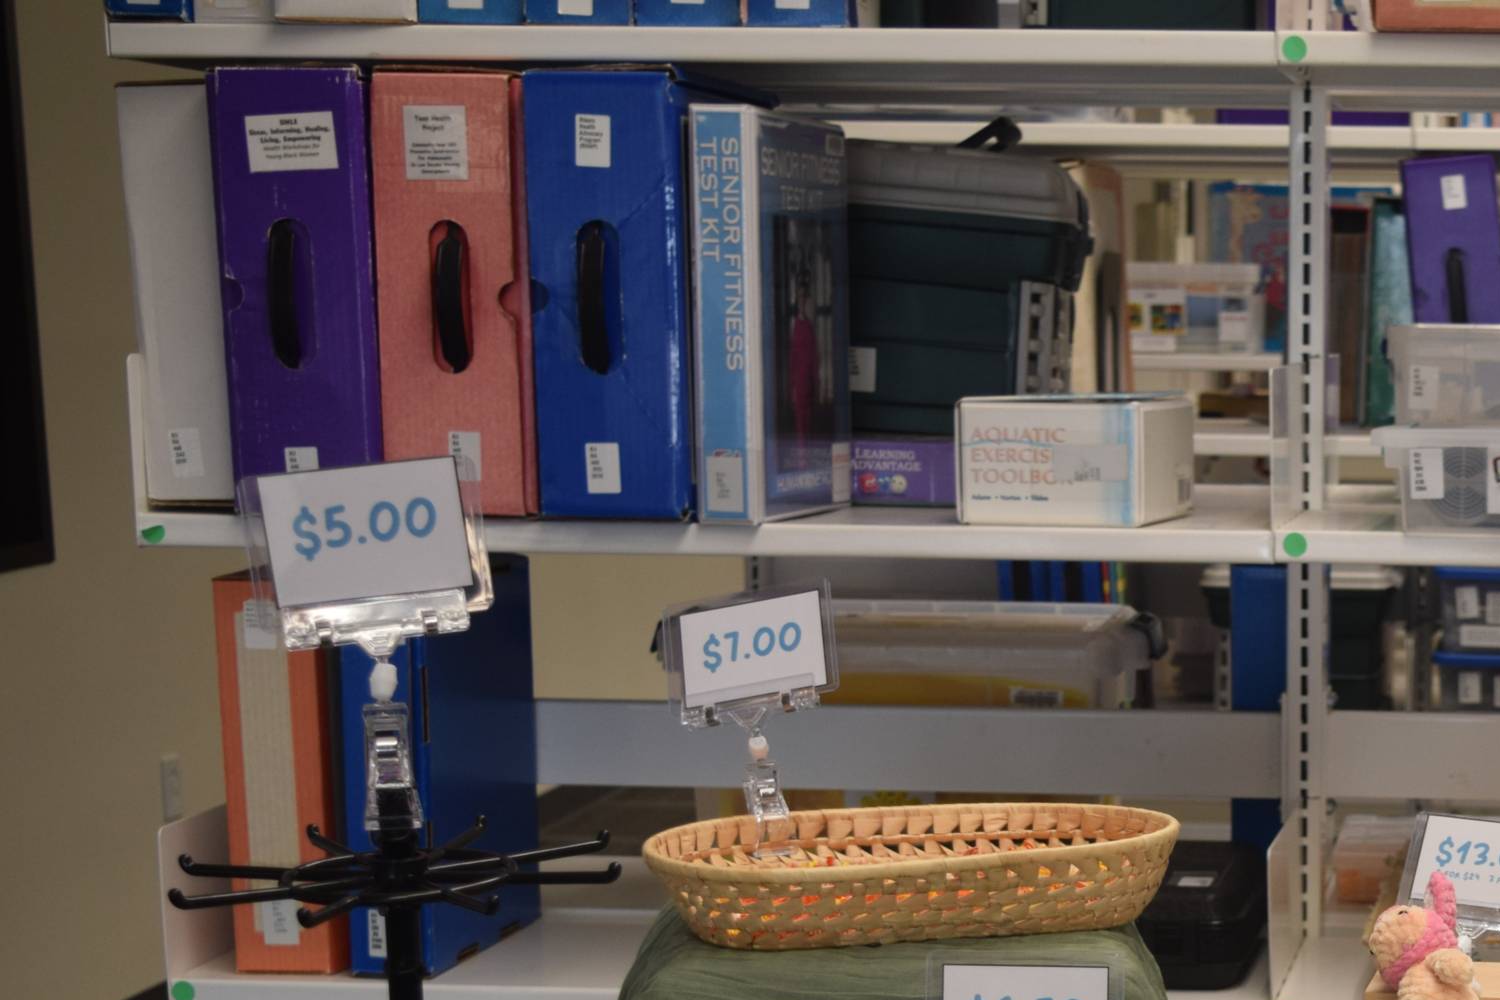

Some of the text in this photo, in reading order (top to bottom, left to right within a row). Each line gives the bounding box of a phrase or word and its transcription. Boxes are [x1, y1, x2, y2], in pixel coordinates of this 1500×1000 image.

[760, 147, 801, 177] SENIOR
[700, 137, 721, 262] TEST KIT
[780, 186, 806, 212] TEST
[721, 137, 744, 372] SENIOR FITNESS
[970, 427, 1066, 445] AQUATIC
[855, 448, 915, 460] LEARNING
[971, 448, 1051, 463] EXERCIS
[970, 468, 1074, 485] TOOLBO
[293, 497, 436, 561] $5.00
[703, 622, 801, 673] $7.00
